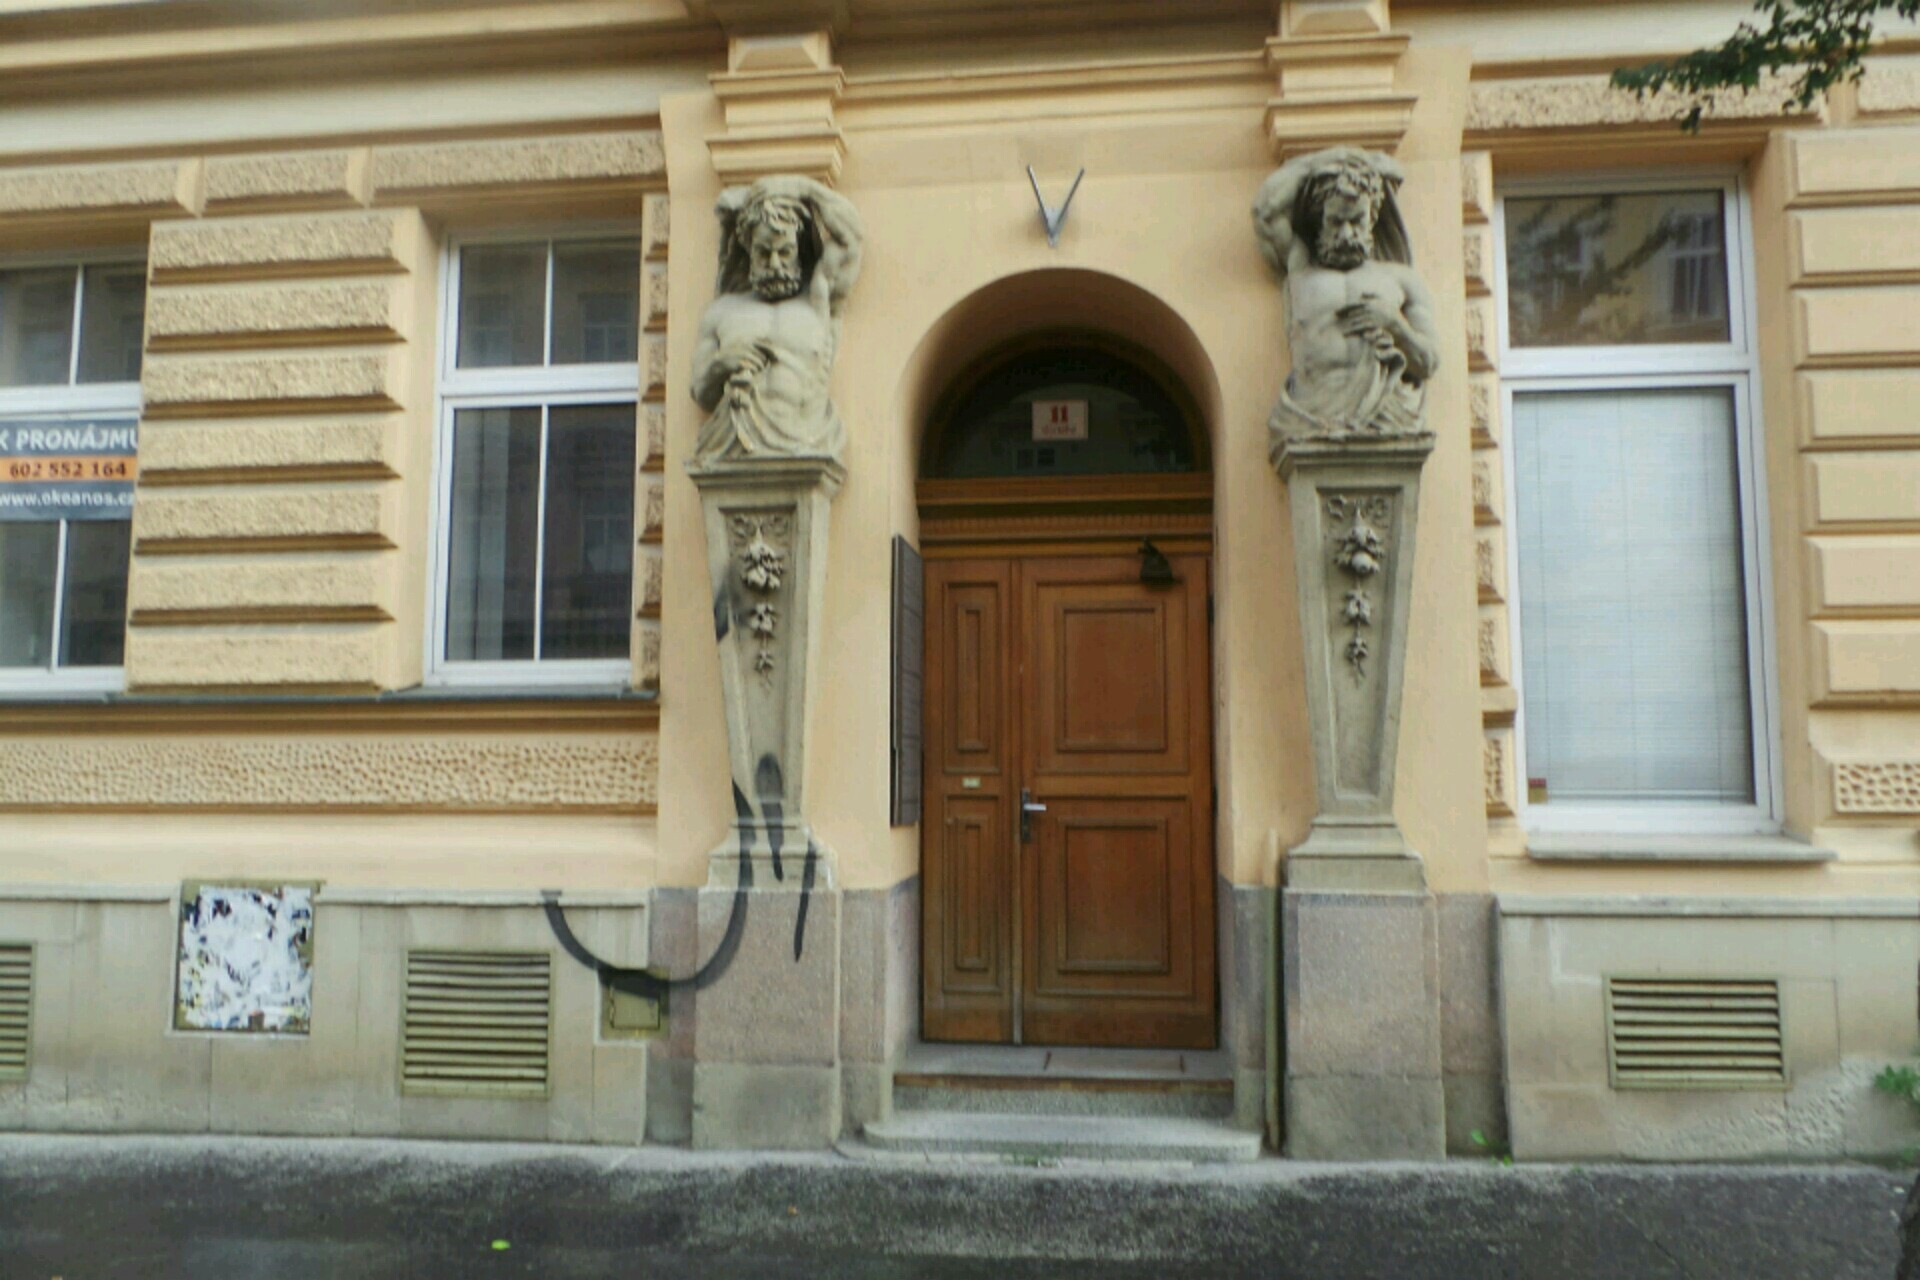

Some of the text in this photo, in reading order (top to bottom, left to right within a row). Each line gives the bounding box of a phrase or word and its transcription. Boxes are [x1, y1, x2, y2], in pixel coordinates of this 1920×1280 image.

[10, 461, 126, 478] 602 552 164
